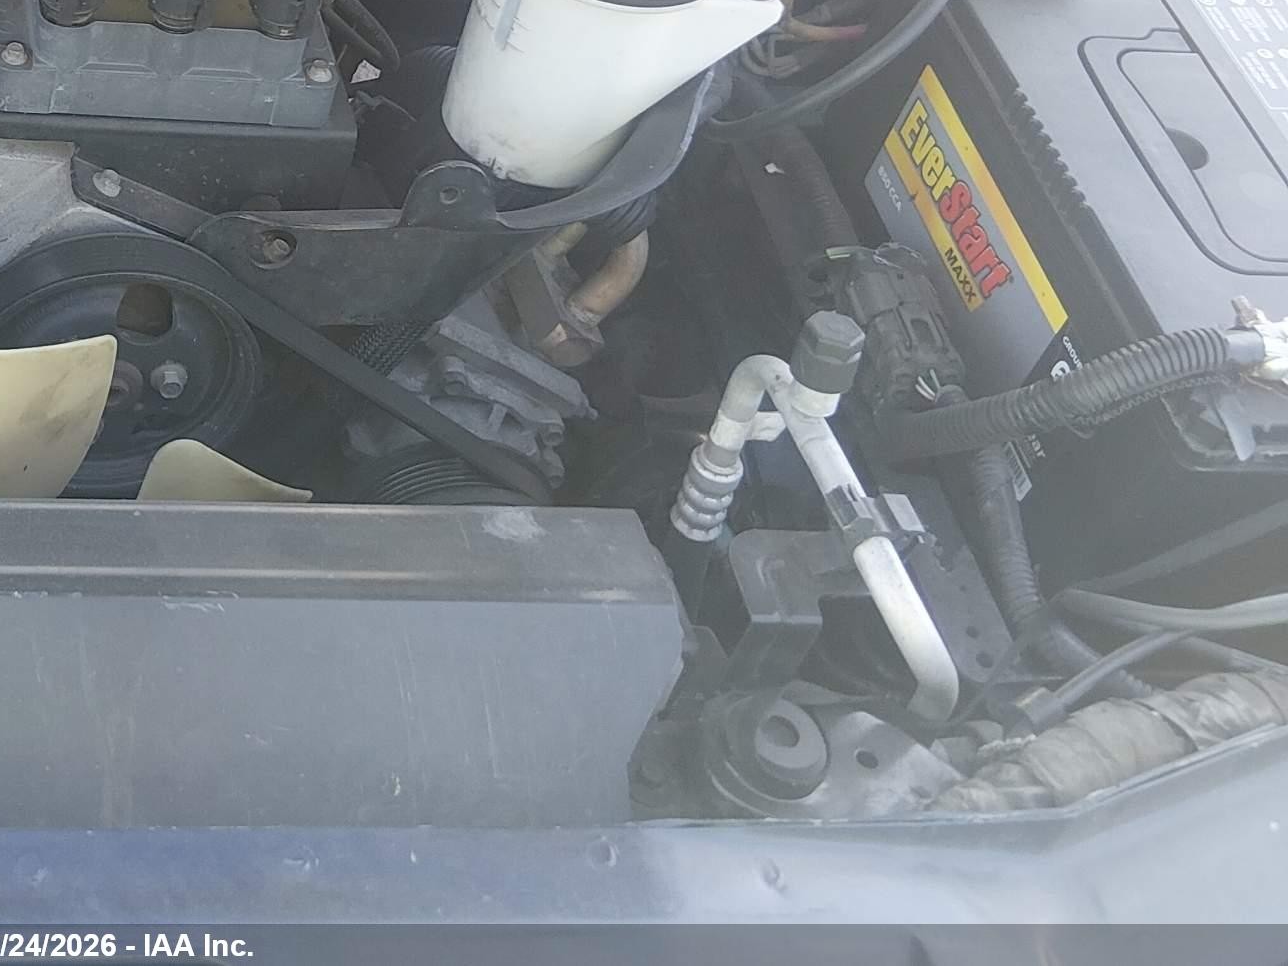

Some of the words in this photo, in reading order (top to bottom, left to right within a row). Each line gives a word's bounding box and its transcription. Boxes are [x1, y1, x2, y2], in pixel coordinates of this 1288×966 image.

[887, 186, 903, 212] CCA
[899, 98, 1011, 298] EverStart
[944, 247, 977, 304] MAXX
